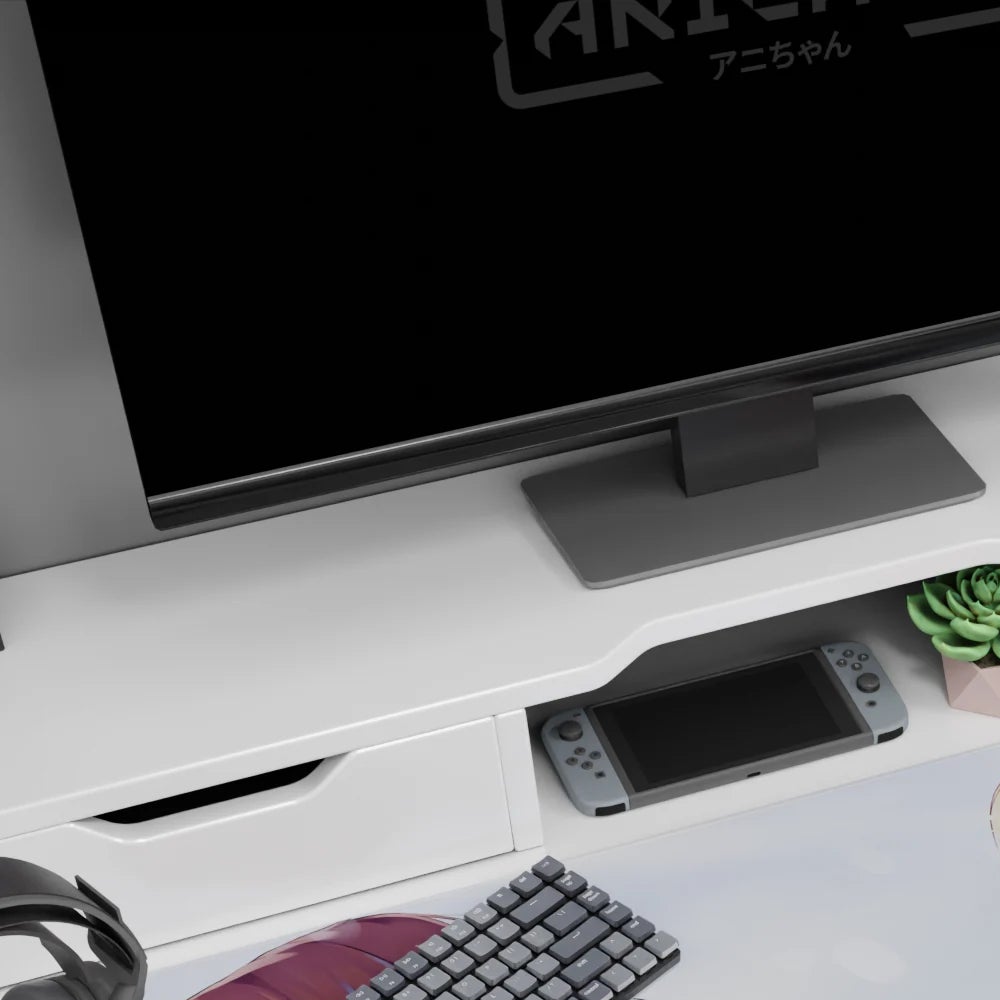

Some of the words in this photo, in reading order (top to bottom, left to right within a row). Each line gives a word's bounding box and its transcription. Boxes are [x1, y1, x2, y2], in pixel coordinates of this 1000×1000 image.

[709, 30, 852, 81] アニちゃん
